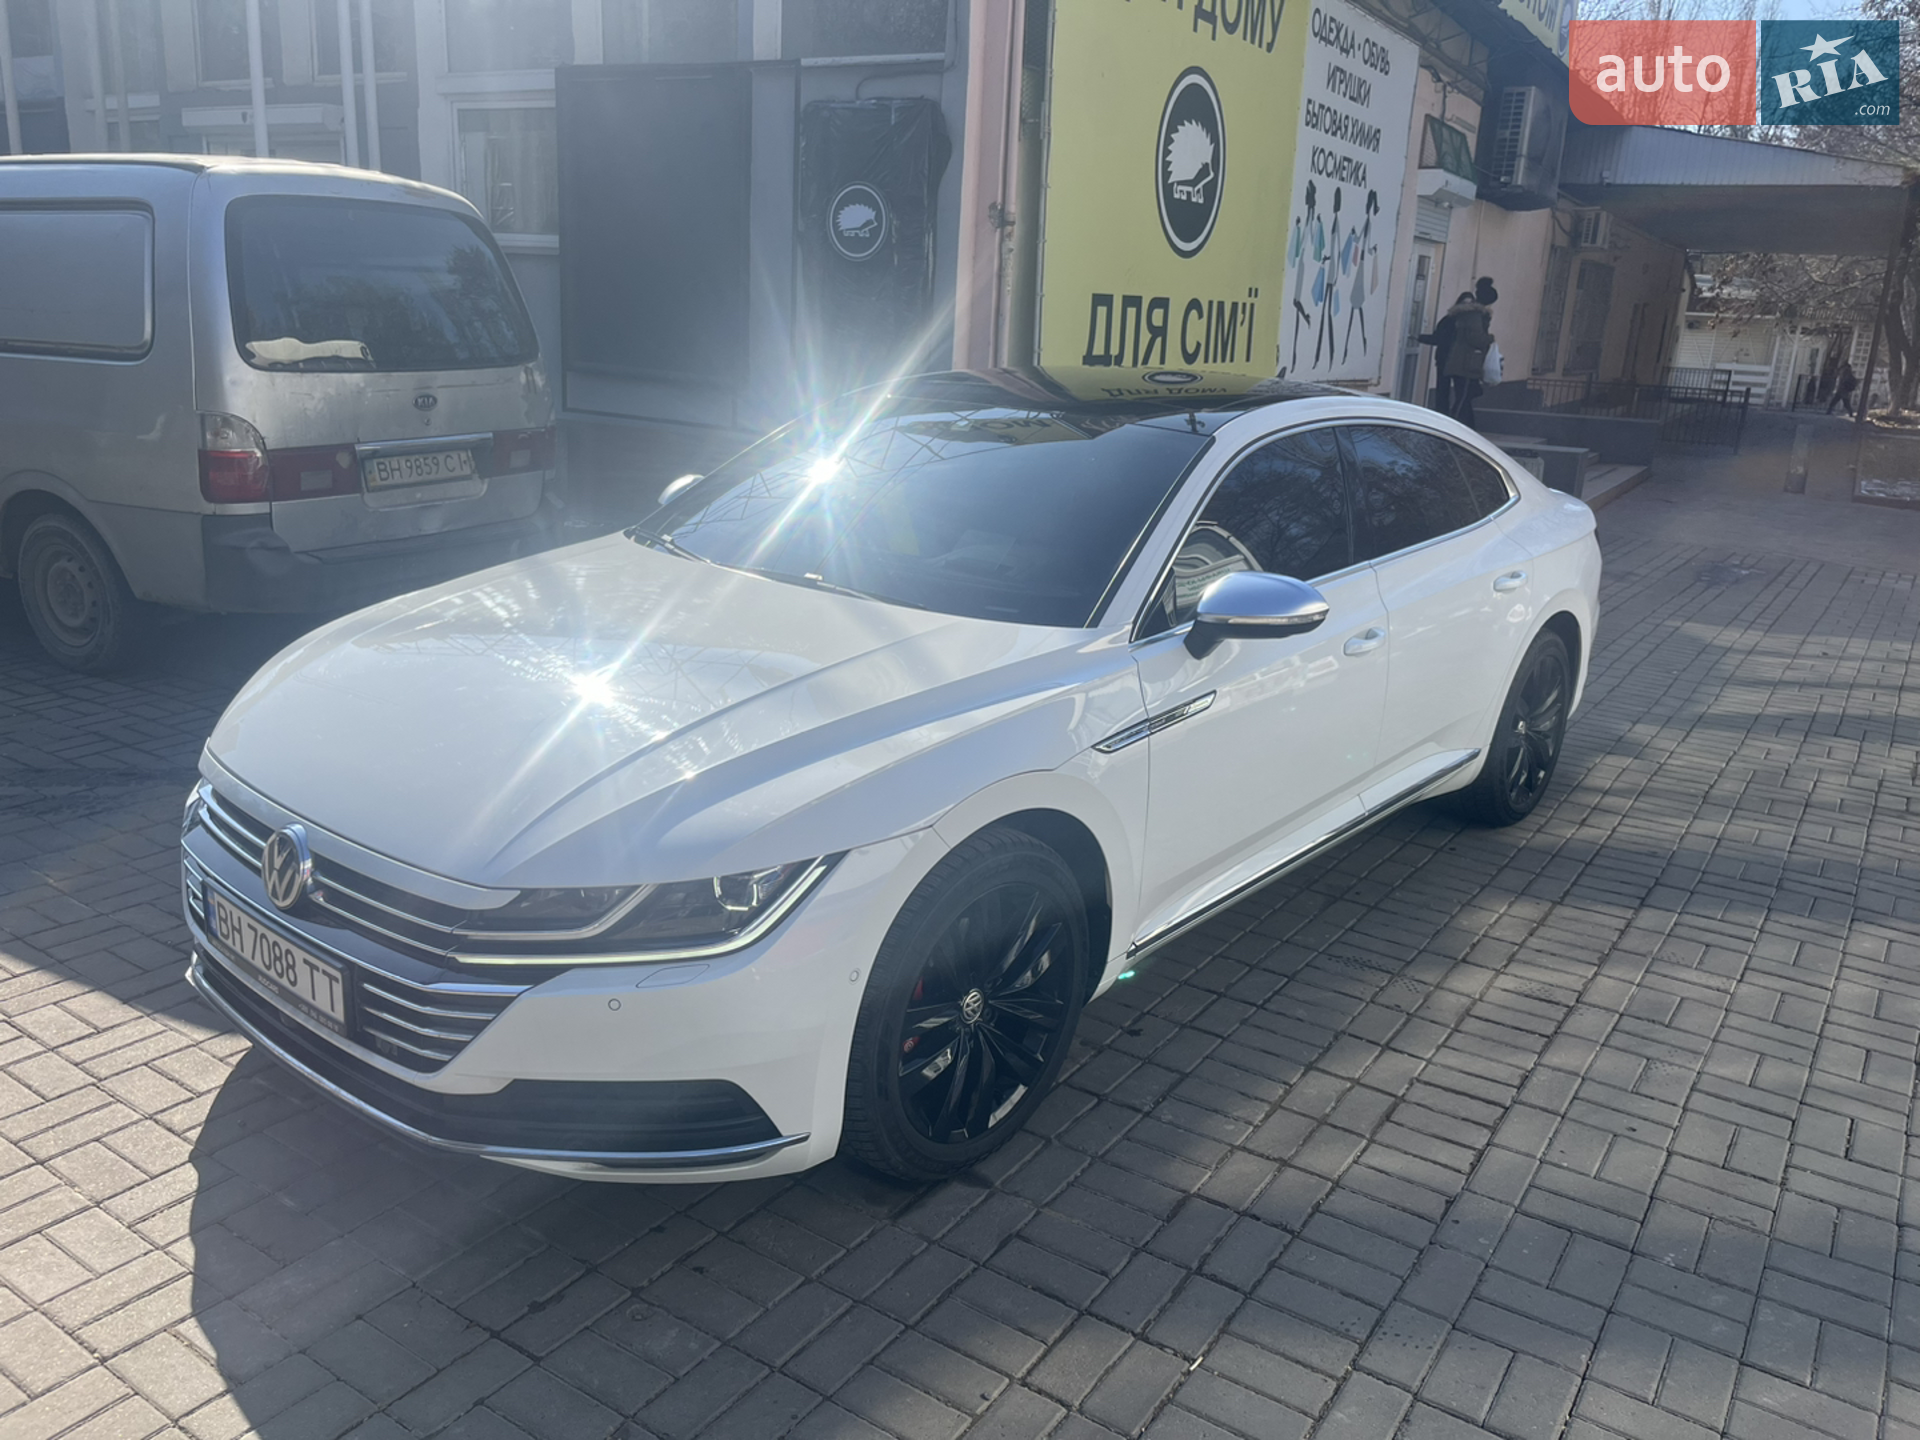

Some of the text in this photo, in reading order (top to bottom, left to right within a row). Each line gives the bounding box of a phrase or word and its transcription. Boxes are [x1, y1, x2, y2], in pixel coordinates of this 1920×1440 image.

[1312, 7, 1391, 76] ОДЕЖДА ОБУВЬ
[1326, 61, 1372, 108] ИГРУШКИ
[1305, 98, 1381, 154] БЫТОВАЯ ХИМИЯ
[1310, 145, 1367, 189] КОСМЕТИКА
[1082, 293, 1170, 368] ДЛЯ
[417, 397, 436, 407] KIA
[376, 453, 464, 481] BH 9859 CI
[217, 900, 340, 1013] BH 7088 TT
